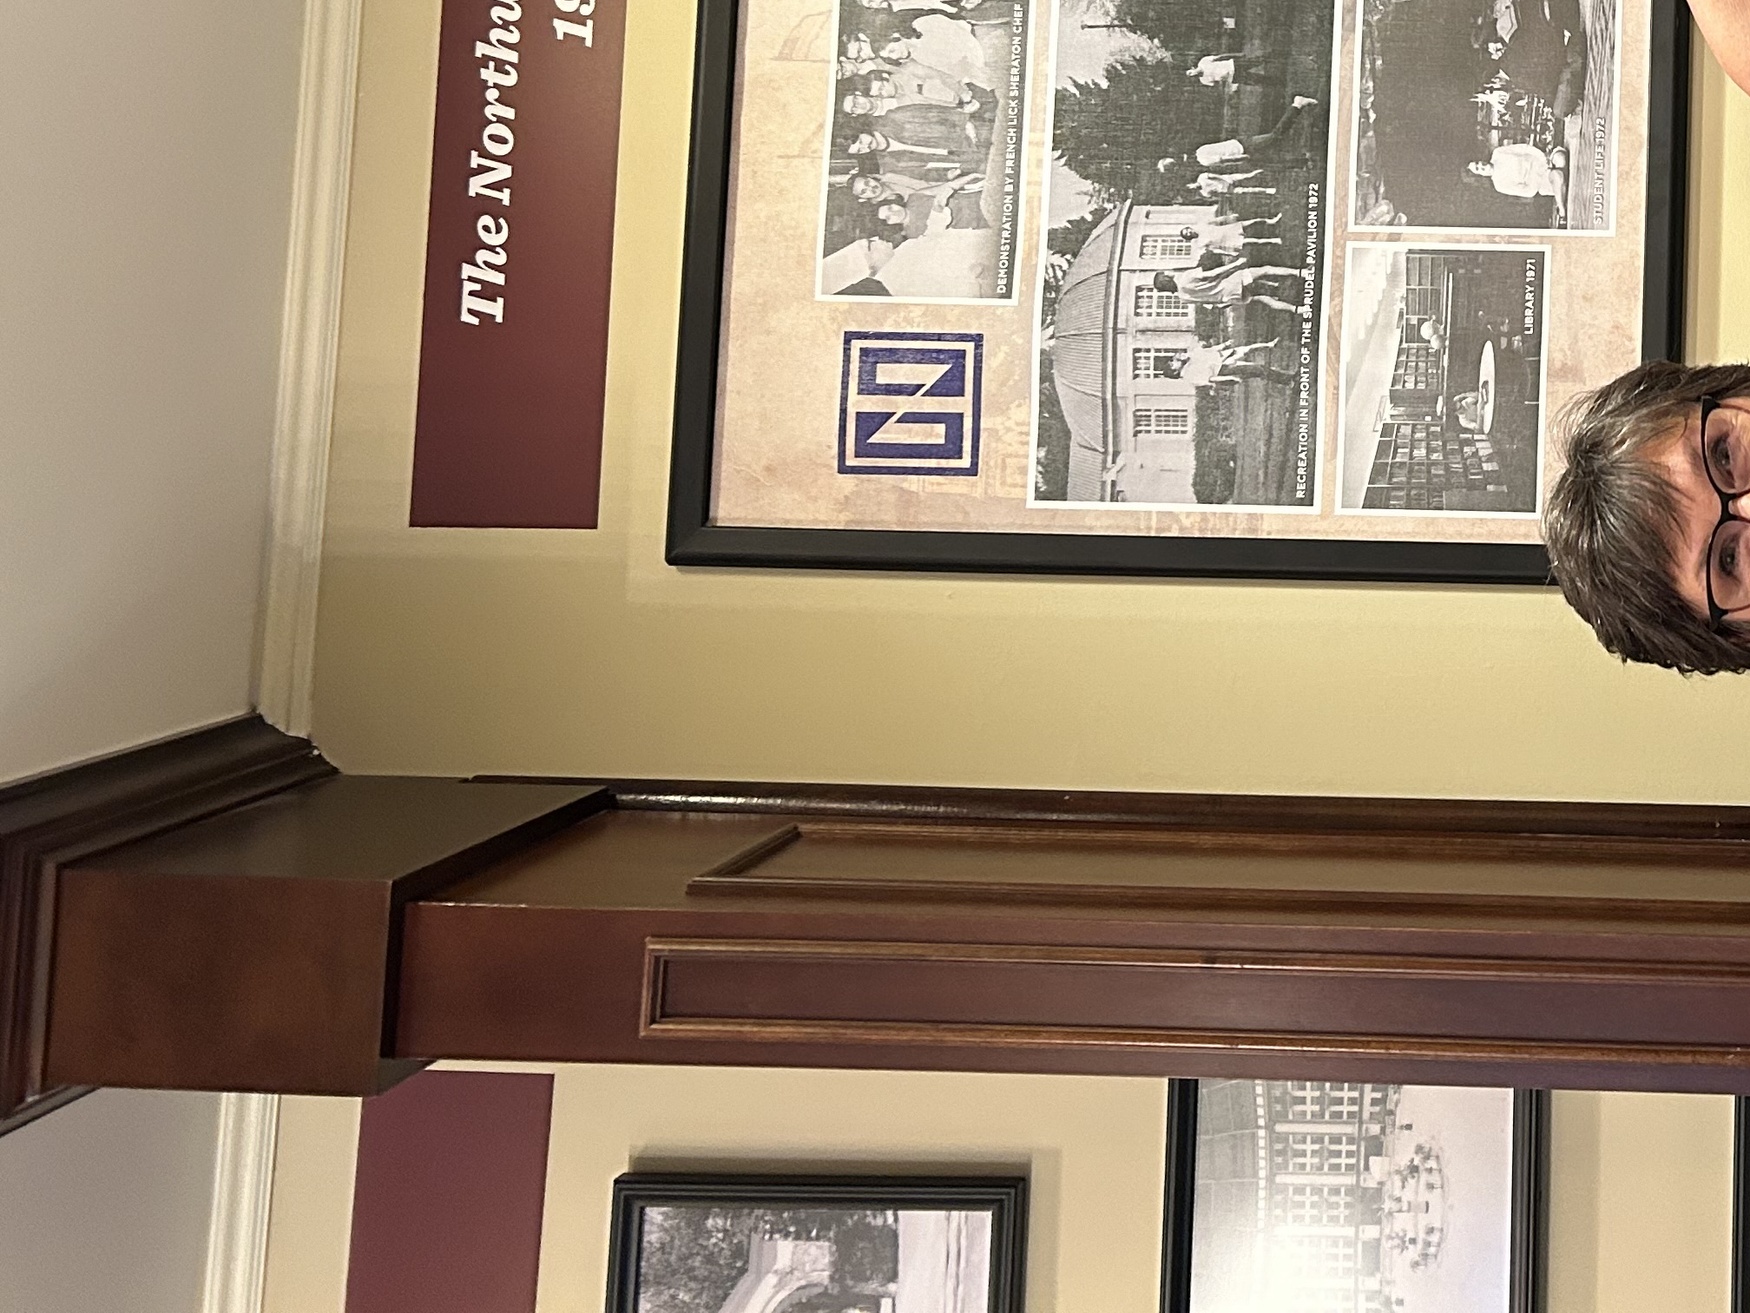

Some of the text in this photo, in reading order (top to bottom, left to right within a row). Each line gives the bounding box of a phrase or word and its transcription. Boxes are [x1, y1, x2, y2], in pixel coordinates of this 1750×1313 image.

[997, 4, 1022, 293] DEMONSTRATION BY FRENCH LICK SHERATON CHEF
[1593, 118, 1605, 224] STUDENT LIFE 1972
[1295, 183, 1318, 498] RECREATION IN FRONT OF THE SPRUDEL PAVILION 1972
[1524, 260, 1535, 334] LIBRARY 1971
